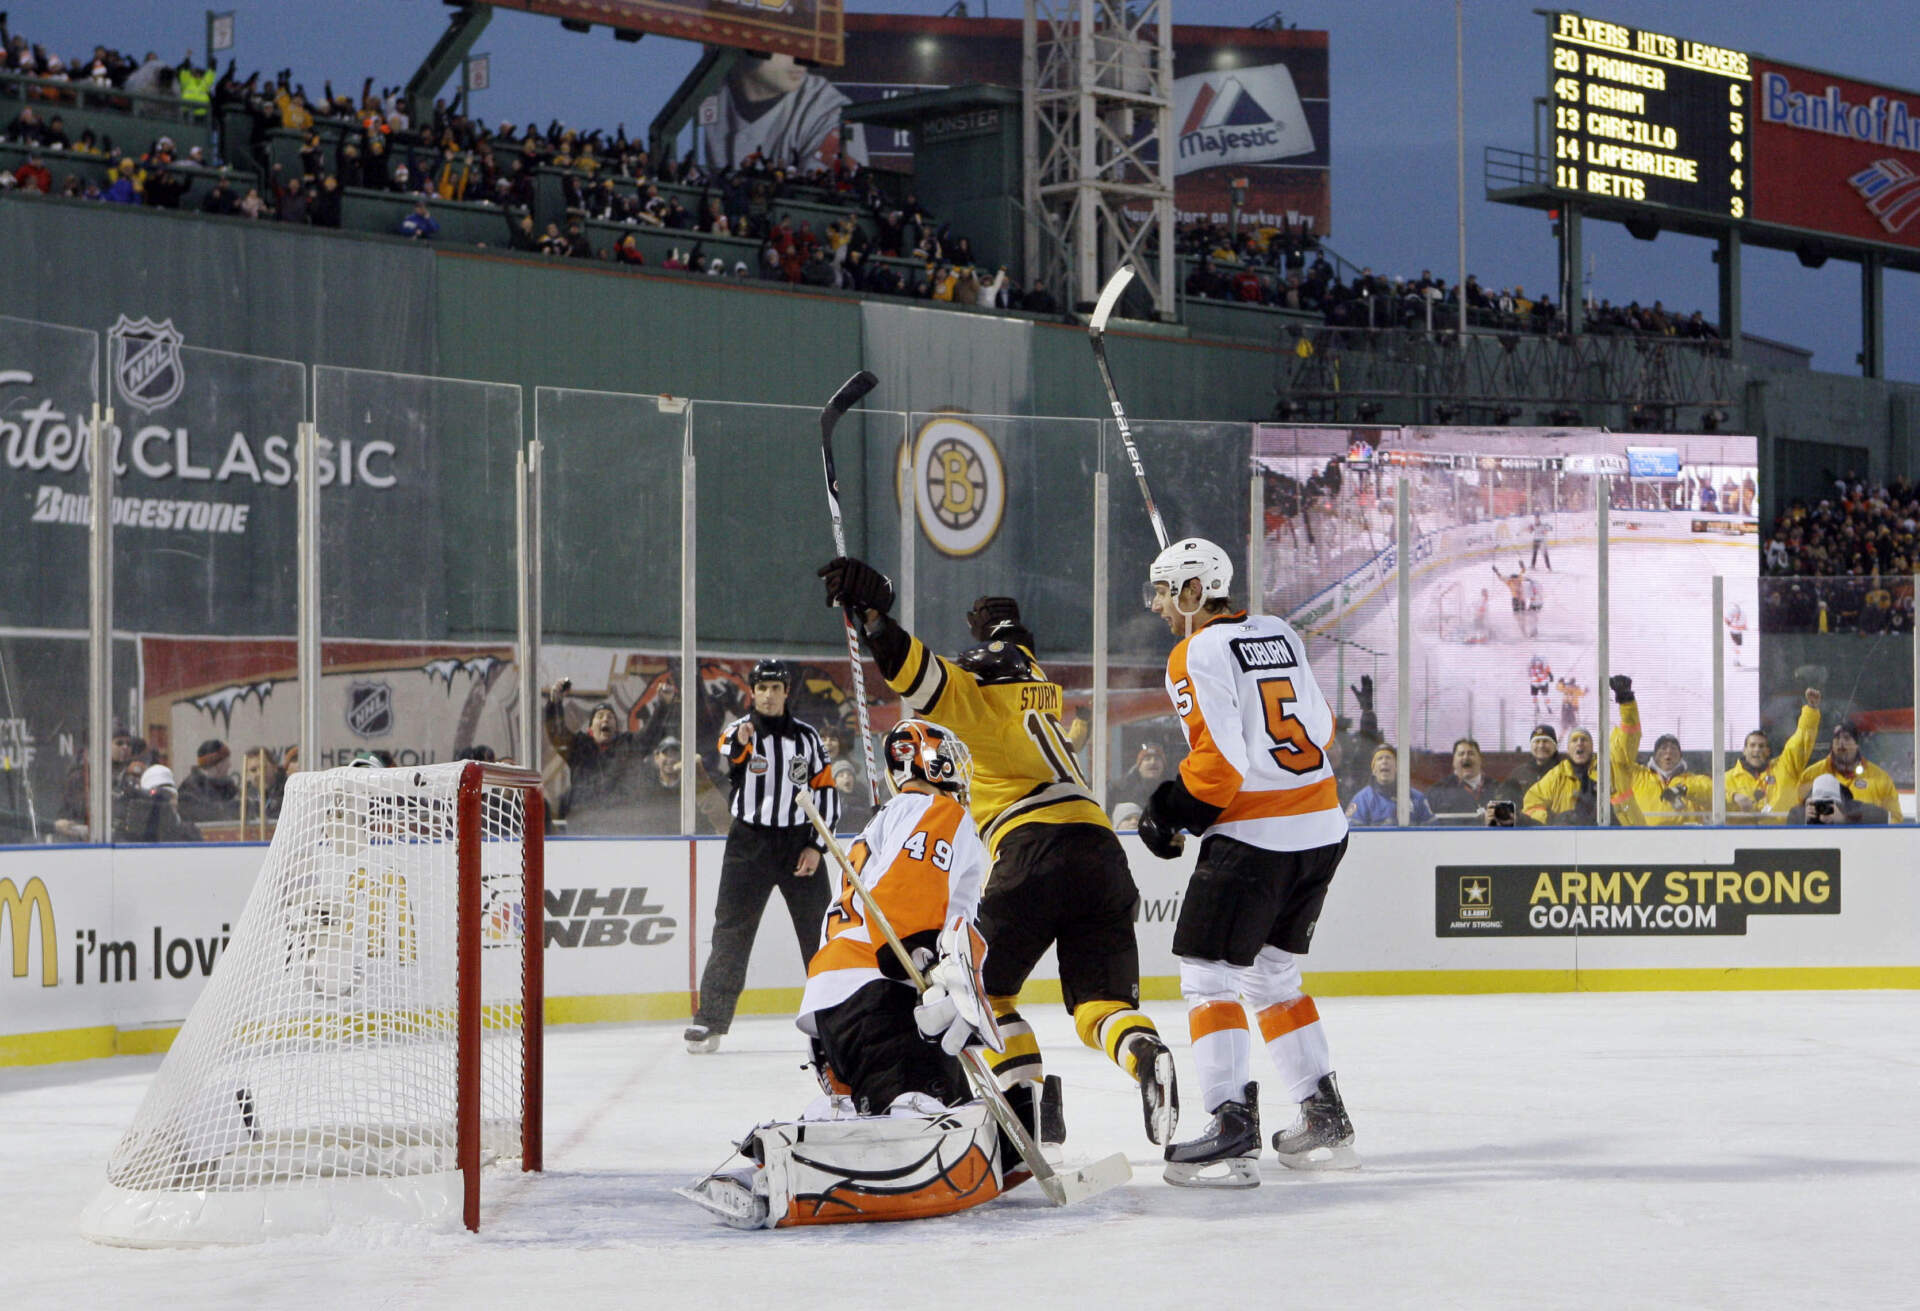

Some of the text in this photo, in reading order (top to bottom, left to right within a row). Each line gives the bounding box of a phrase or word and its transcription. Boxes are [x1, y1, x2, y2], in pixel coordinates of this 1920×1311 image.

[1559, 13, 1749, 75] FLYERS HITS LEADERS
[1554, 47, 1743, 107] 20 PRONGER 6
[1554, 77, 1744, 135] 45 ASHAM 5
[1763, 72, 1850, 137] Bank
[1851, 95, 1887, 145] of
[1179, 127, 1279, 159] Majestic
[1556, 106, 1744, 163] 13 CARCILLO 4
[1556, 136, 1744, 191] 14 LAPERRIERE 4
[1556, 165, 1744, 219] 11 BETTS 3
[129, 343, 170, 390] NHL
[1111, 401, 1145, 477] BAUER
[1239, 639, 1293, 667] COBURN
[354, 696, 388, 730] NHL
[1020, 684, 1058, 711] STURM
[1173, 677, 1194, 718] 5
[1256, 676, 1324, 776] 5
[902, 831, 954, 873] 49
[544, 887, 664, 917] NHL
[1529, 870, 1831, 905] ARMY STRONG
[544, 917, 677, 948] NBC
[1450, 921, 1471, 929] ARMY
[1529, 905, 1717, 929] GOARMY.COM
